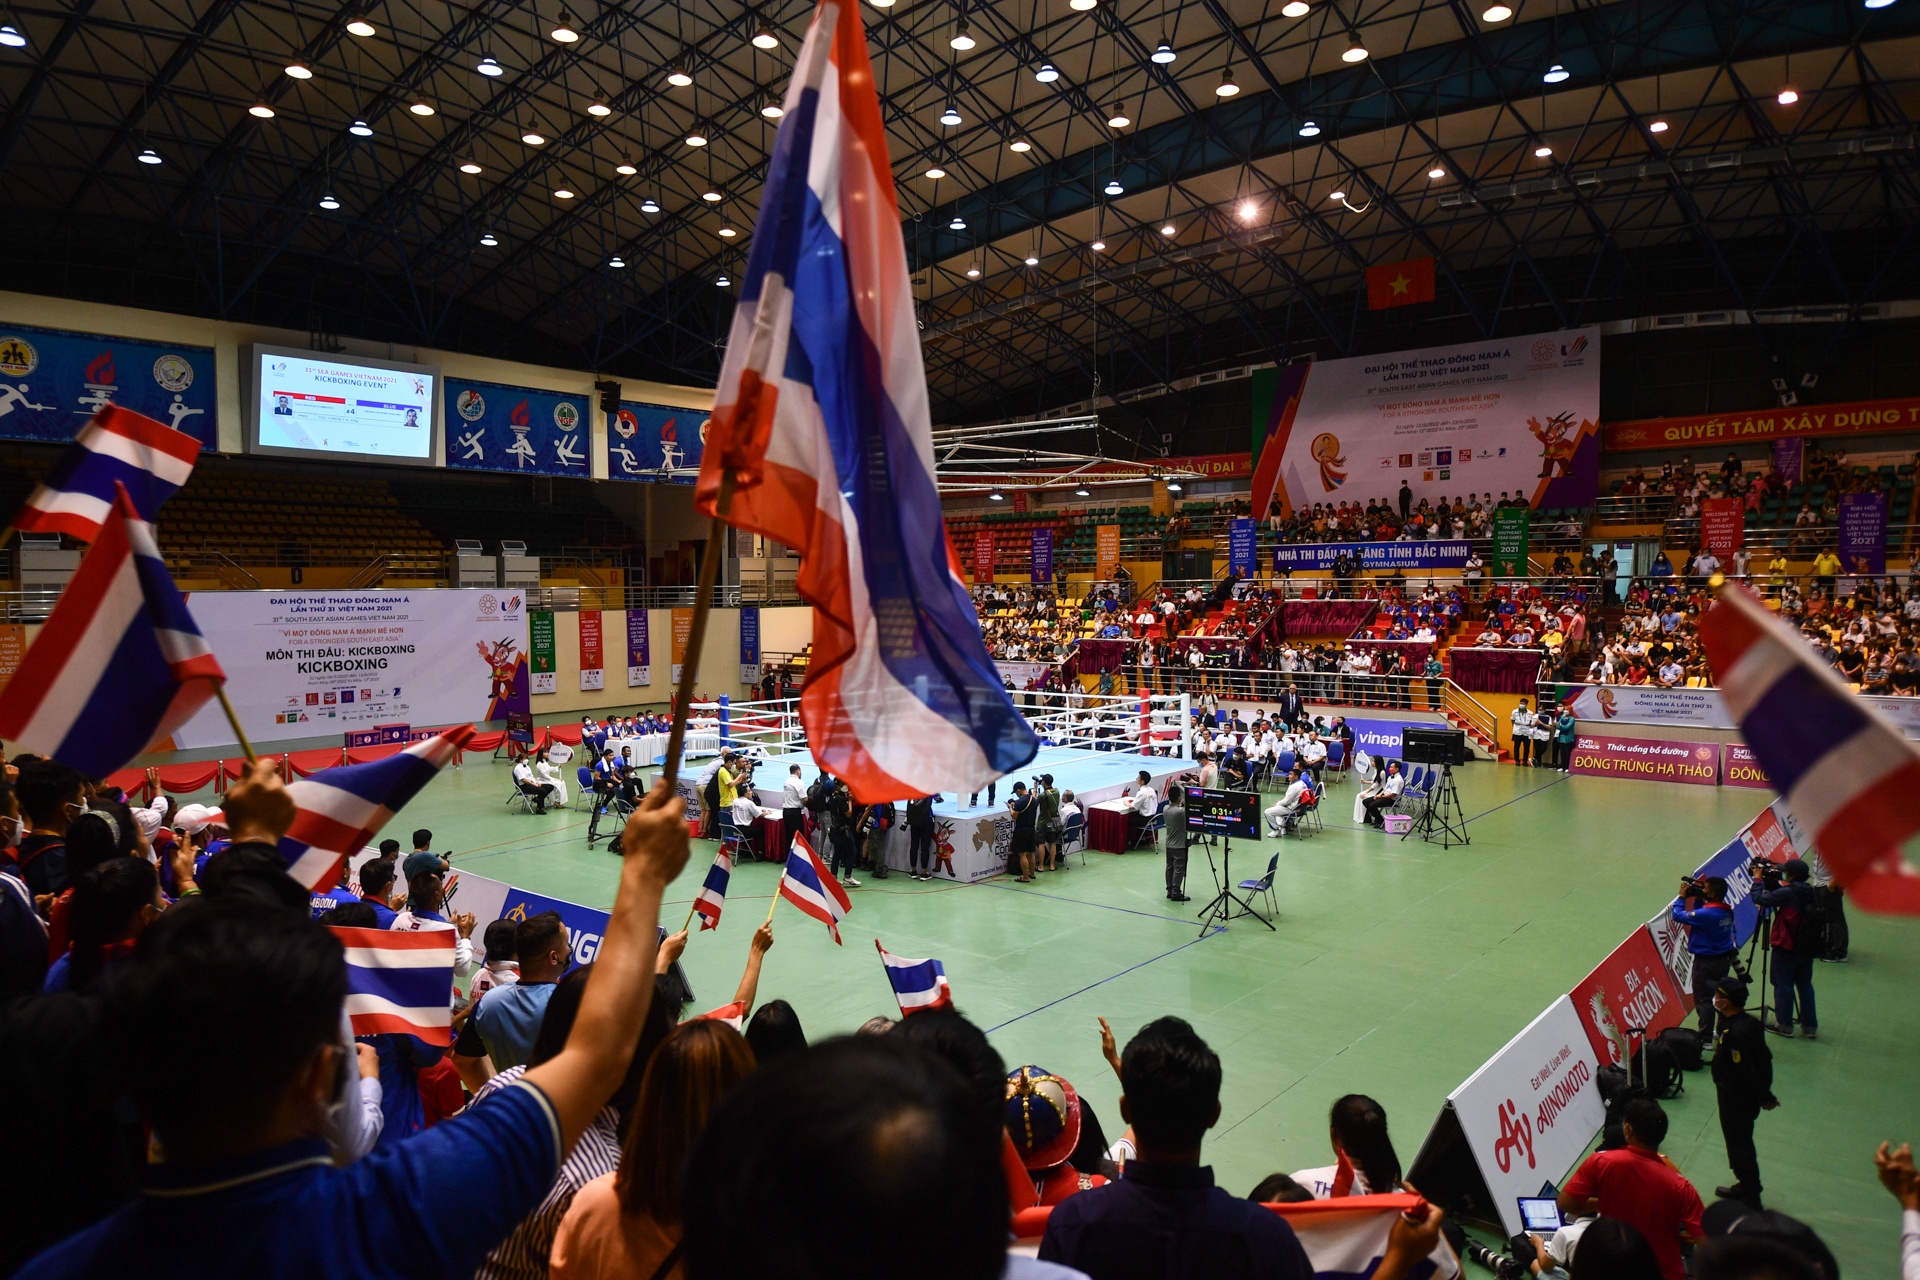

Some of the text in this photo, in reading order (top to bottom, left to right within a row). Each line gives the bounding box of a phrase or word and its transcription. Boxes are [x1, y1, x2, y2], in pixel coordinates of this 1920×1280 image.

[1365, 348, 1510, 376] ĐẠI HỘI THAO ĐÔNG NAM Á
[331, 370, 353, 379] GAMES
[354, 374, 382, 382] VIETNAM
[1430, 368, 1447, 377] VIỆT
[1450, 366, 1470, 374] NAM
[1472, 364, 1490, 372] 2021
[315, 375, 388, 389] KICKBOXING EVENT
[1438, 379, 1460, 388] GAMES
[1403, 400, 1422, 409] ĐÔNG
[1402, 408, 1436, 417] STRONGER
[1664, 418, 1725, 441] QUYẾT
[1732, 417, 1775, 435] TÂM
[1782, 414, 1827, 431] XÂY
[1834, 408, 1901, 430] DỰNG
[1198, 461, 1209, 473] VĨ
[1213, 461, 1234, 476] ĐẠI
[1278, 549, 1297, 560] NHÀ
[1300, 550, 1314, 560] THI
[1388, 544, 1412, 558] TỈNH
[1415, 543, 1437, 558] BẮC
[1440, 546, 1467, 557] NINH
[270, 598, 287, 606] ĐẠI
[290, 597, 306, 606] HỘI
[266, 645, 415, 660] MÔN THI ĐẤU: KICKBOXING
[298, 658, 388, 674] KICKBOXING
[1607, 743, 1626, 751] Thức
[1627, 745, 1648, 754] uống
[1649, 745, 1660, 754] bổ
[1662, 747, 1689, 758] dưỡng
[1575, 756, 1713, 778] ĐÔNG TRÙNG HẠ THẢO
[1624, 968, 1641, 993] BIA
[1622, 977, 1666, 1039] SAIGON
[1530, 1044, 1572, 1091] Eat Well, Live Well.
[1537, 1060, 1589, 1134] AJINOMOTO
